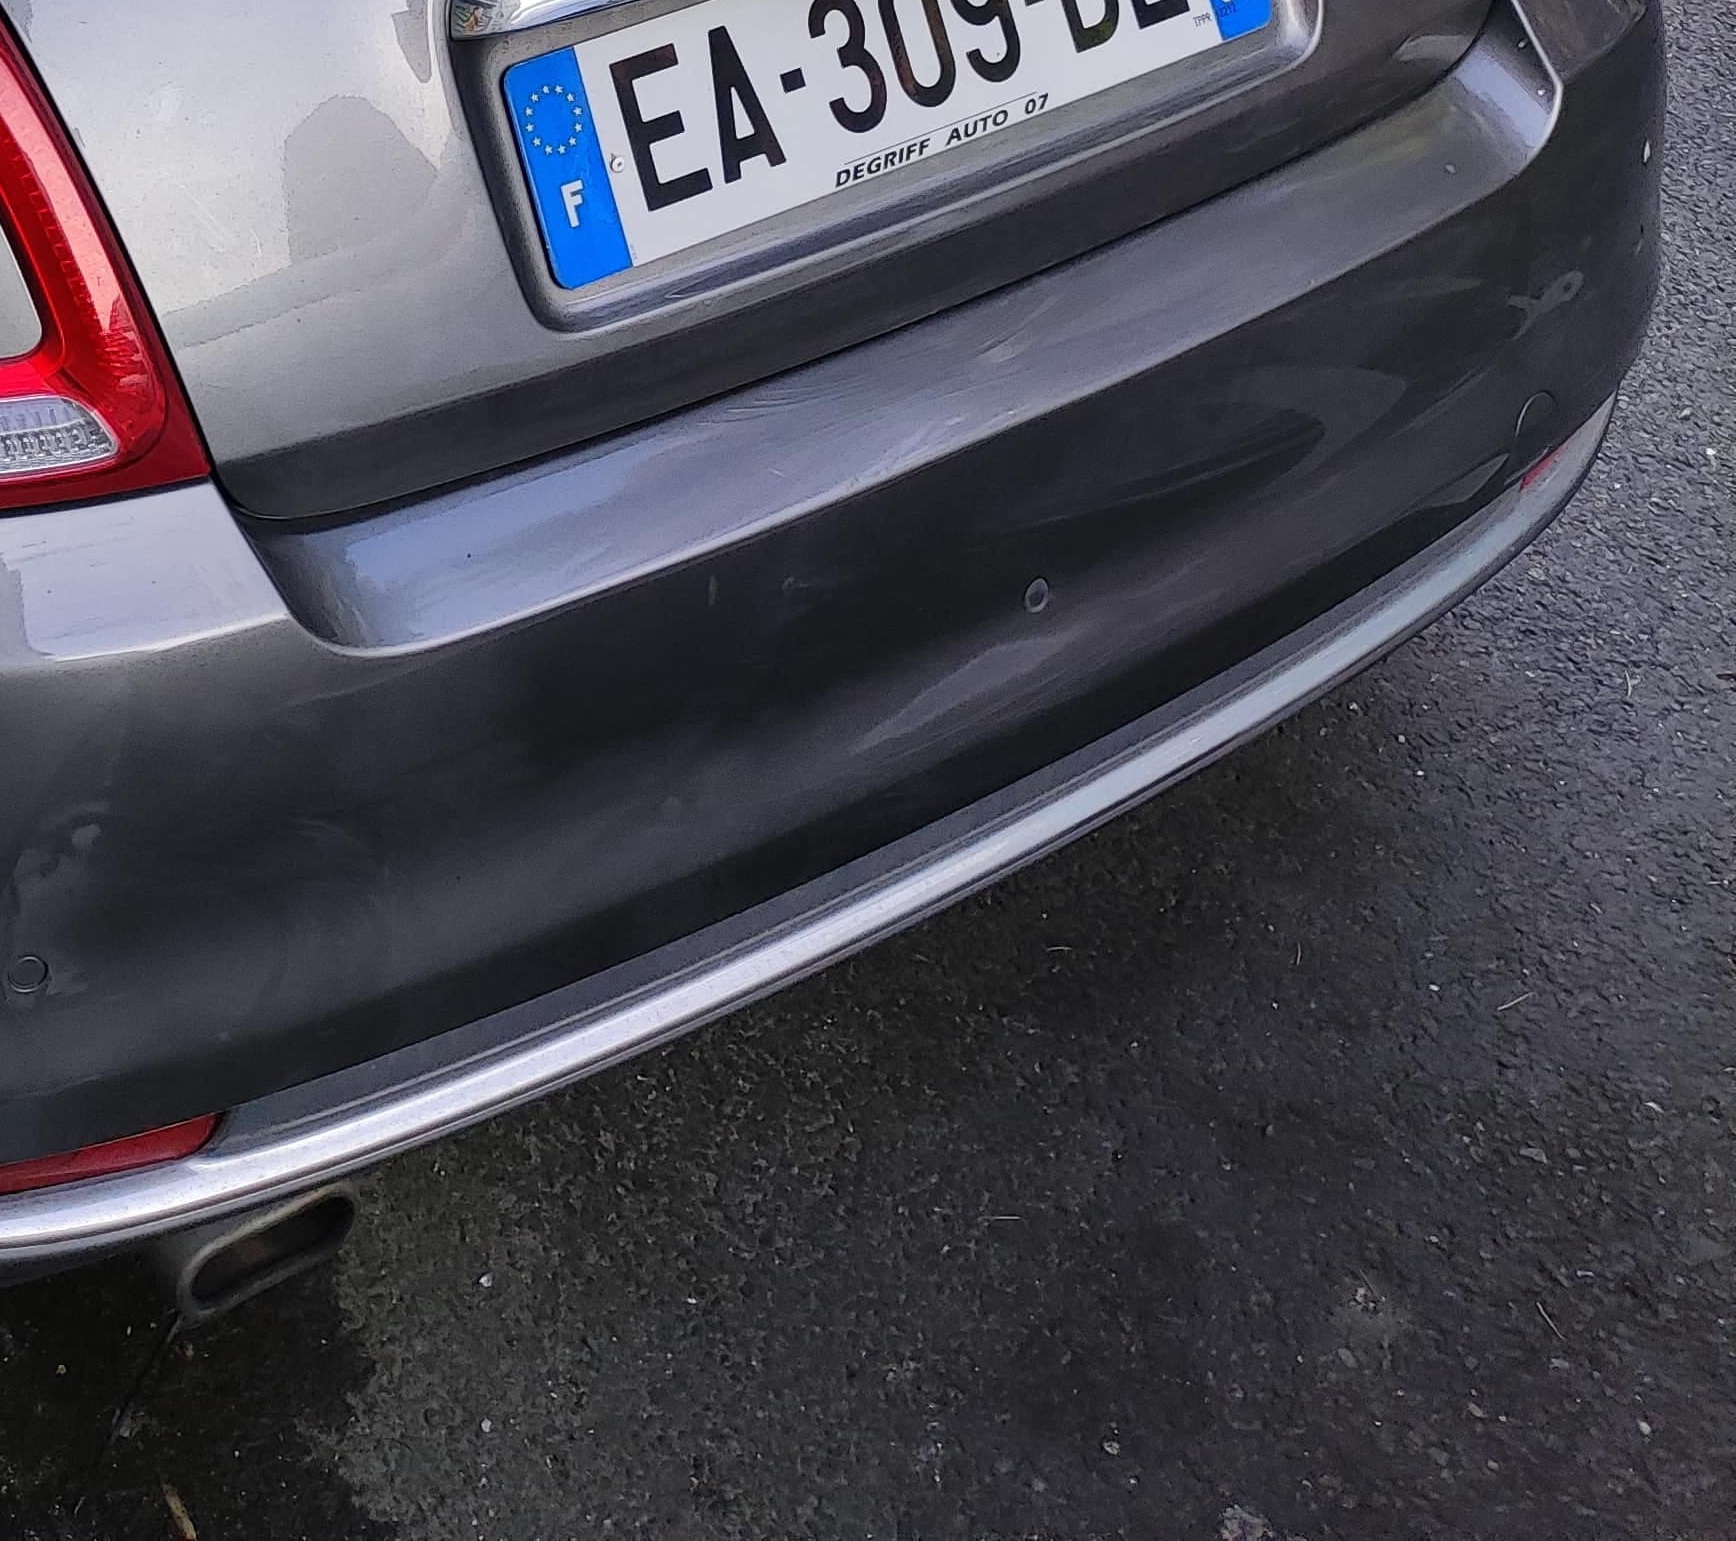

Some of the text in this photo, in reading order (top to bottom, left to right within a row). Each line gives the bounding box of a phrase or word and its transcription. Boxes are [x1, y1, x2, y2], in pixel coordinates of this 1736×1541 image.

[835, 92, 1049, 188] DEGRIFF AUTO 07
[560, 179, 584, 228] F
